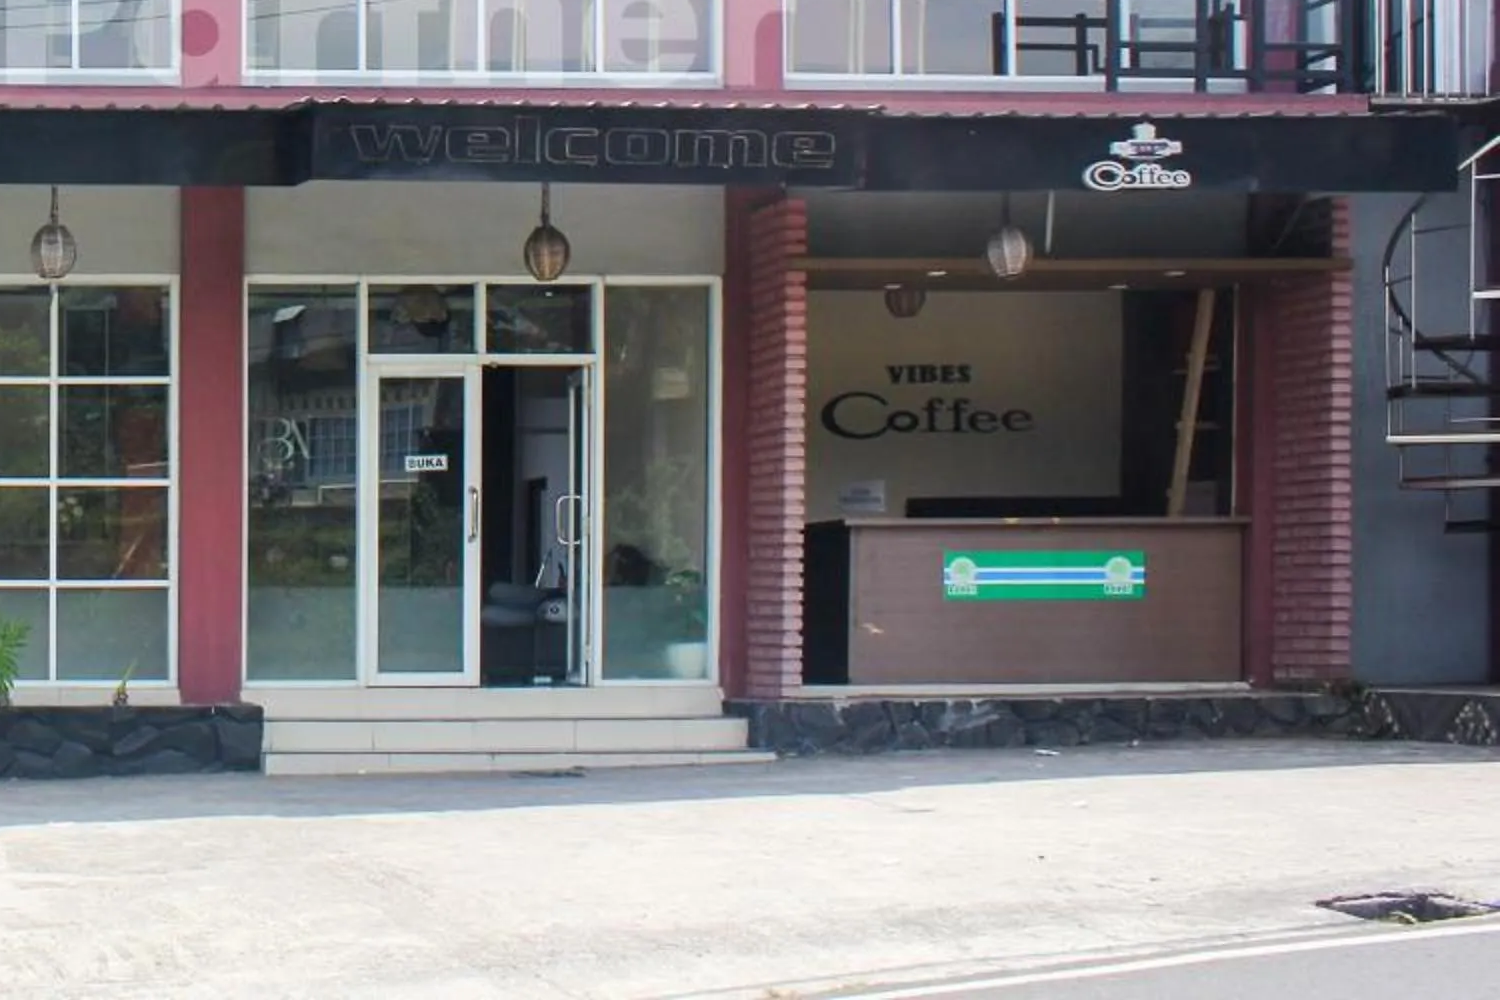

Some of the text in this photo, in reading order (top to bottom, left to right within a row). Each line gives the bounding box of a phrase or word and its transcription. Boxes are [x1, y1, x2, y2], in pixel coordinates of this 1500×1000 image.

[350, 116, 836, 168] welcome
[1083, 161, 1191, 191] Coffee
[886, 364, 972, 384] VIBES
[821, 391, 1034, 440] Coffee
[408, 456, 445, 469] BUKA
